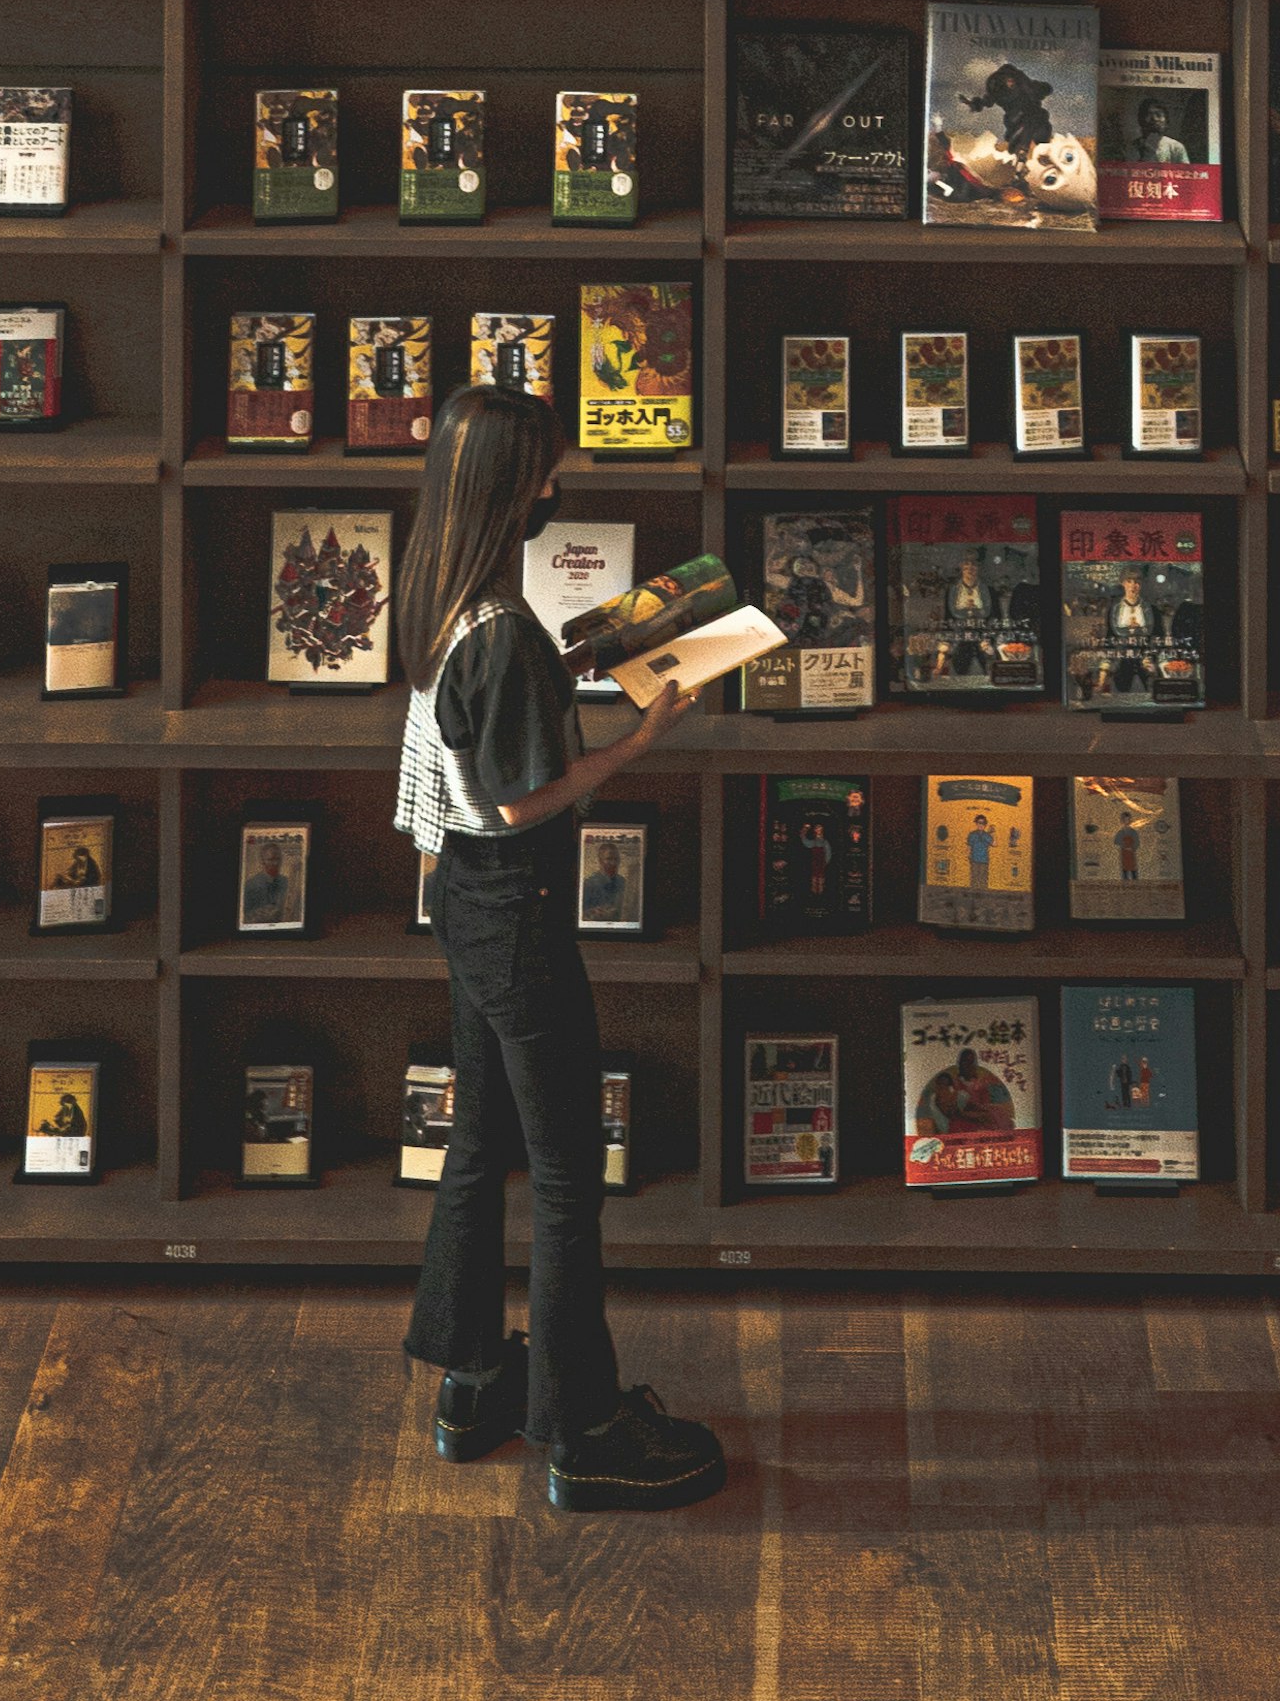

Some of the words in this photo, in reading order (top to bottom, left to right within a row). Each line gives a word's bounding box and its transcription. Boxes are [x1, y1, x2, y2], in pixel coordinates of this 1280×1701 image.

[757, 115, 795, 128] FAR
[842, 115, 884, 129] OUT
[586, 407, 671, 426] ゴッホ入門
[1068, 527, 1170, 558] 印象派
[803, 653, 865, 672] クリムト
[164, 1244, 197, 1258] 4038
[720, 1250, 751, 1264] 4039
